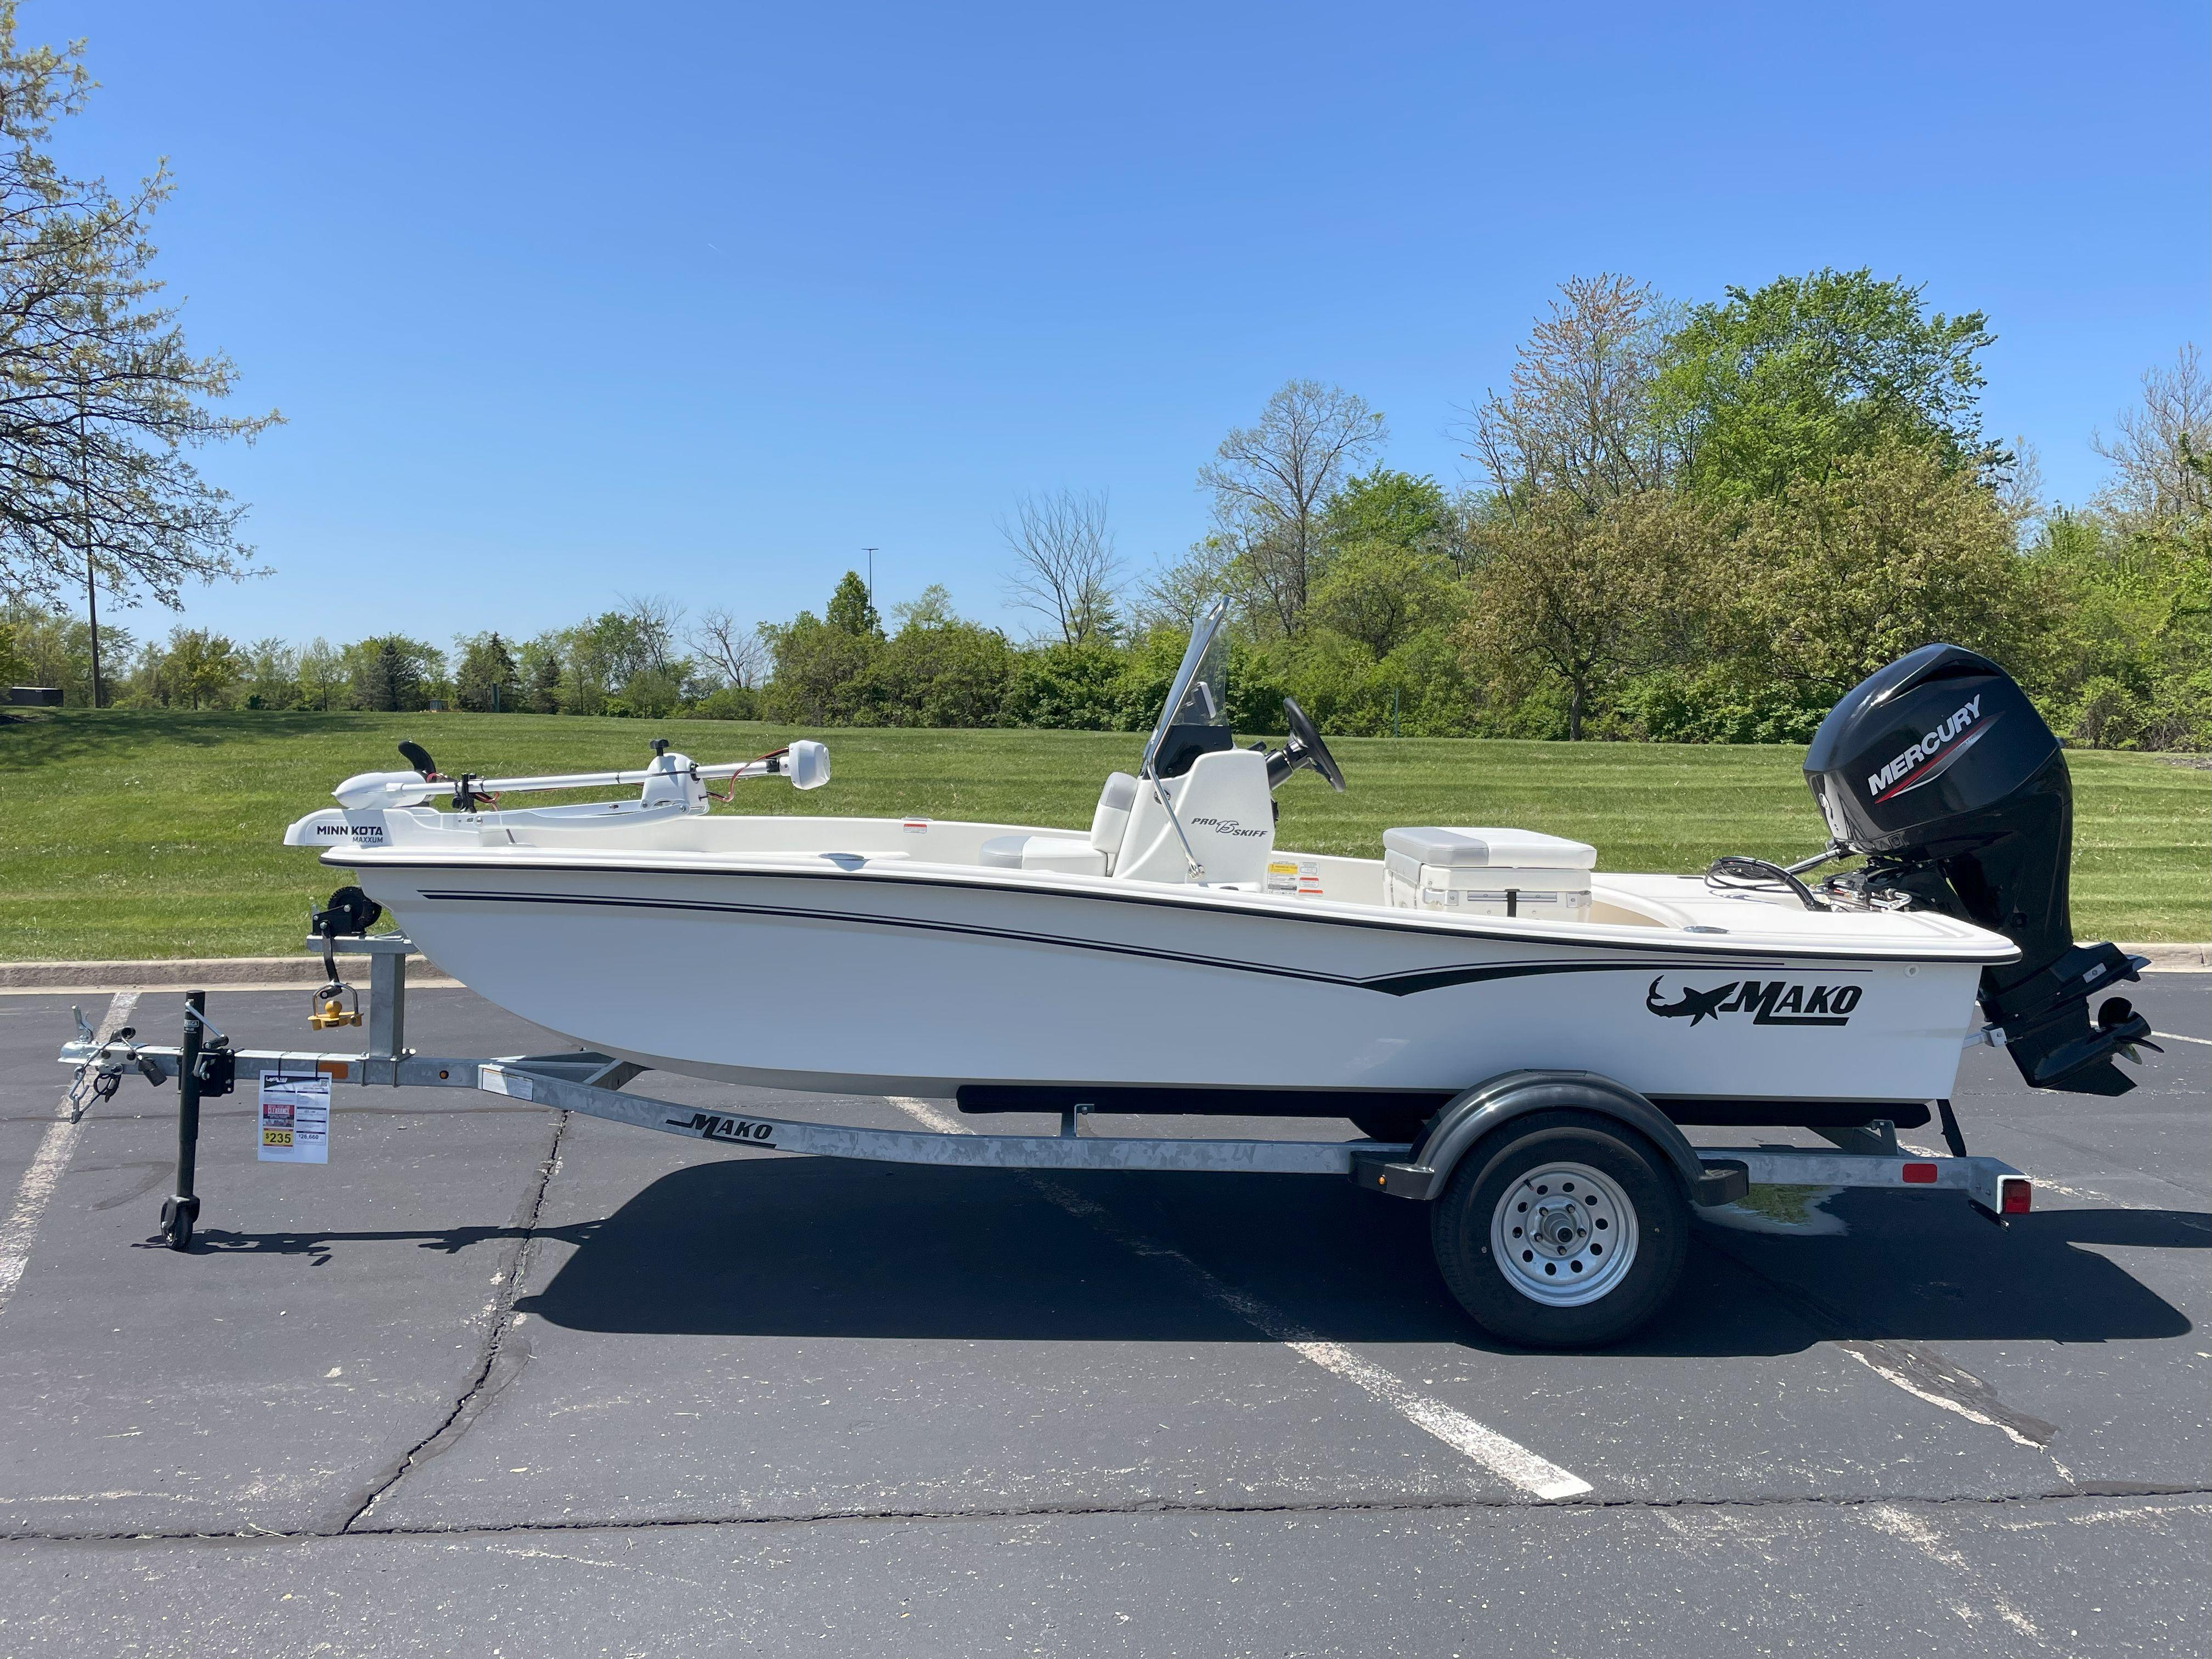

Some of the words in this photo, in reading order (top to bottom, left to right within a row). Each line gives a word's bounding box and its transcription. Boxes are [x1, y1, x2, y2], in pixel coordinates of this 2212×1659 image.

[1868, 694, 1980, 795] MERCURY
[317, 826, 348, 835] MINN
[351, 826, 383, 835] KOTA
[1215, 820, 1239, 833] 15
[1232, 829, 1268, 837] SKIFF
[1718, 980, 1863, 1026] MAKO
[266, 1132, 291, 1143] $235
[665, 1113, 777, 1149] MAKO
